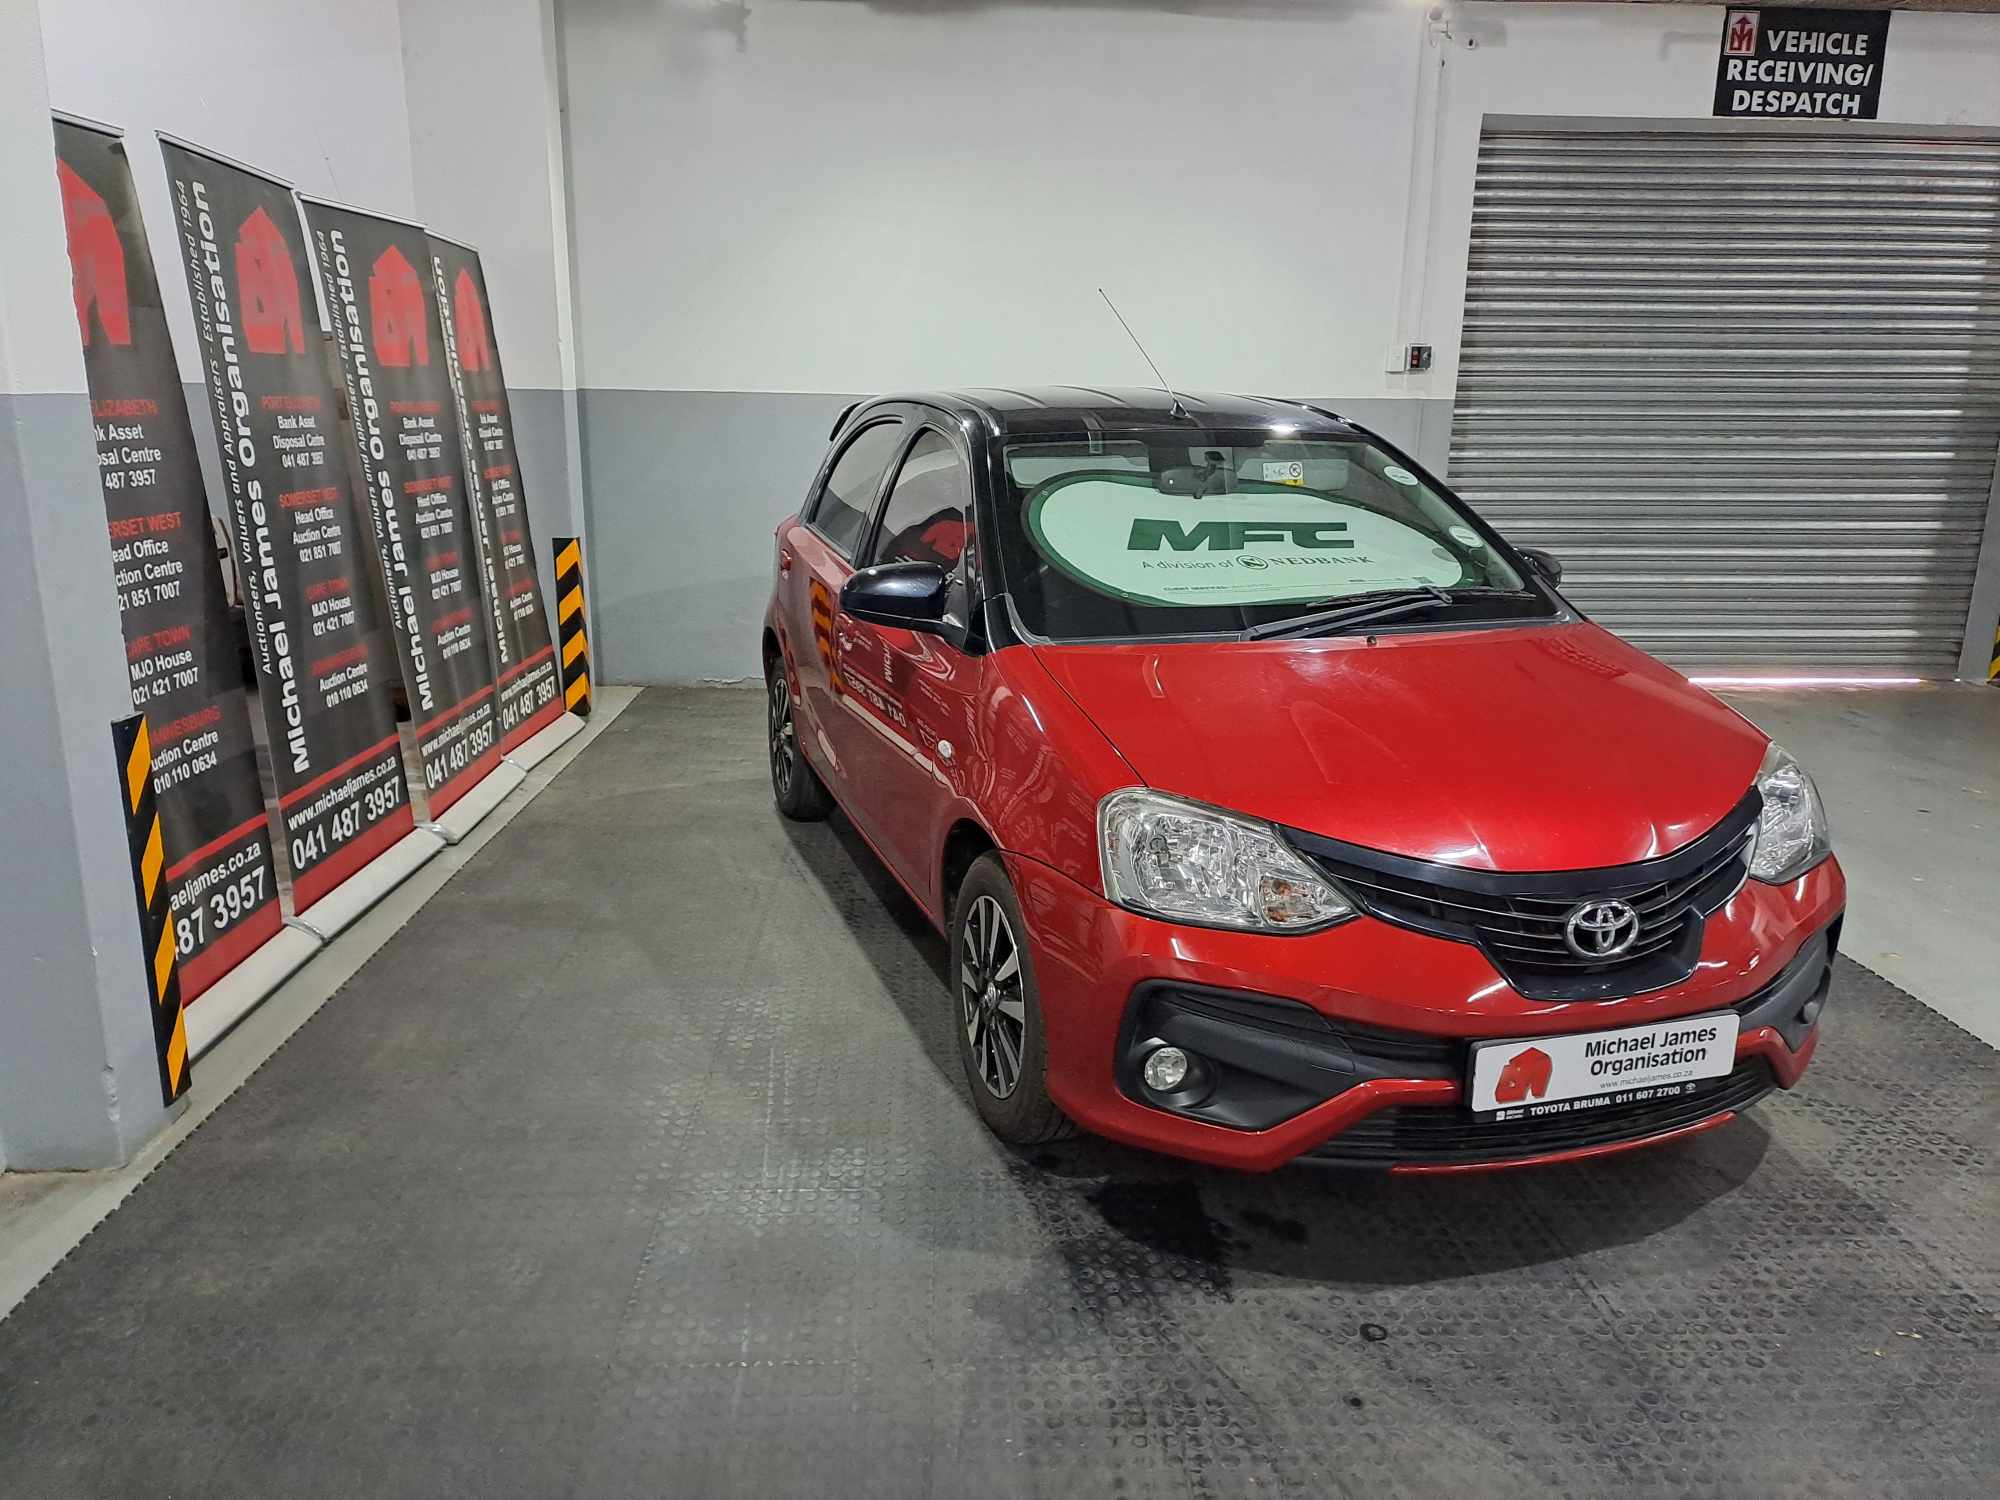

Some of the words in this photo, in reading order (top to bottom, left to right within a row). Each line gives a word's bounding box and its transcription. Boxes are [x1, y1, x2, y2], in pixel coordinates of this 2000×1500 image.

[1767, 29, 1869, 56] VEHICLE
[1726, 59, 1875, 87] RECEIVING/
[1731, 89, 1861, 115] DESPATCH
[175, 179, 193, 228] 1964
[184, 233, 214, 342] Established
[192, 181, 256, 468] Organisation
[330, 230, 385, 460] Organisation
[210, 358, 234, 456] Appraisers
[108, 423, 144, 441] Asset
[121, 446, 162, 464] Centre
[105, 472, 125, 489] 487
[129, 469, 156, 487] 3957
[226, 459, 241, 494] and
[378, 470, 408, 577] James
[1127, 518, 1355, 552] MFC
[112, 543, 132, 562] ead
[133, 539, 169, 558] Office
[247, 480, 282, 610] James
[1141, 560, 1152, 569] A
[1156, 559, 1215, 571] division
[1219, 558, 1235, 569] of
[1271, 555, 1375, 566] NEDBANK
[115, 568, 142, 587] ction
[144, 560, 183, 580] Centre
[118, 593, 130, 611] 21
[131, 587, 152, 607] 851
[153, 581, 181, 601] 7007
[248, 570, 273, 674] Auctioneers,
[130, 659, 154, 681] MJO
[154, 650, 193, 672] House
[398, 586, 434, 711] Michael
[132, 684, 151, 705] 021
[152, 676, 171, 696] 421
[173, 666, 199, 689] 7007
[269, 621, 310, 774] Michael
[502, 701, 519, 730] 041
[519, 689, 535, 718] 487
[535, 675, 556, 705] 3957
[151, 746, 182, 772] uction
[182, 731, 219, 755] Centre
[153, 773, 171, 794] 010
[171, 762, 190, 784] 110
[191, 750, 217, 774] 0634
[425, 754, 449, 789] 041
[450, 738, 469, 771] 487
[469, 720, 493, 756] 3957
[287, 756, 397, 831] www.michaeljames.co.za
[292, 824, 327, 869] 041
[331, 800, 361, 842] 487
[364, 776, 400, 821] 3957
[169, 842, 261, 912] aeljames.co.za
[175, 906, 205, 960] 87
[210, 865, 265, 929] 3957
[1584, 1032, 1656, 1058] Michael
[1659, 1025, 1717, 1048] James
[1590, 1046, 1707, 1077] Organisation
[1530, 1102, 1571, 1116] TOYOTA
[1573, 1096, 1611, 1110] BRUMA
[1615, 1092, 1633, 1104] 011
[1656, 1086, 1681, 1097] 2700
